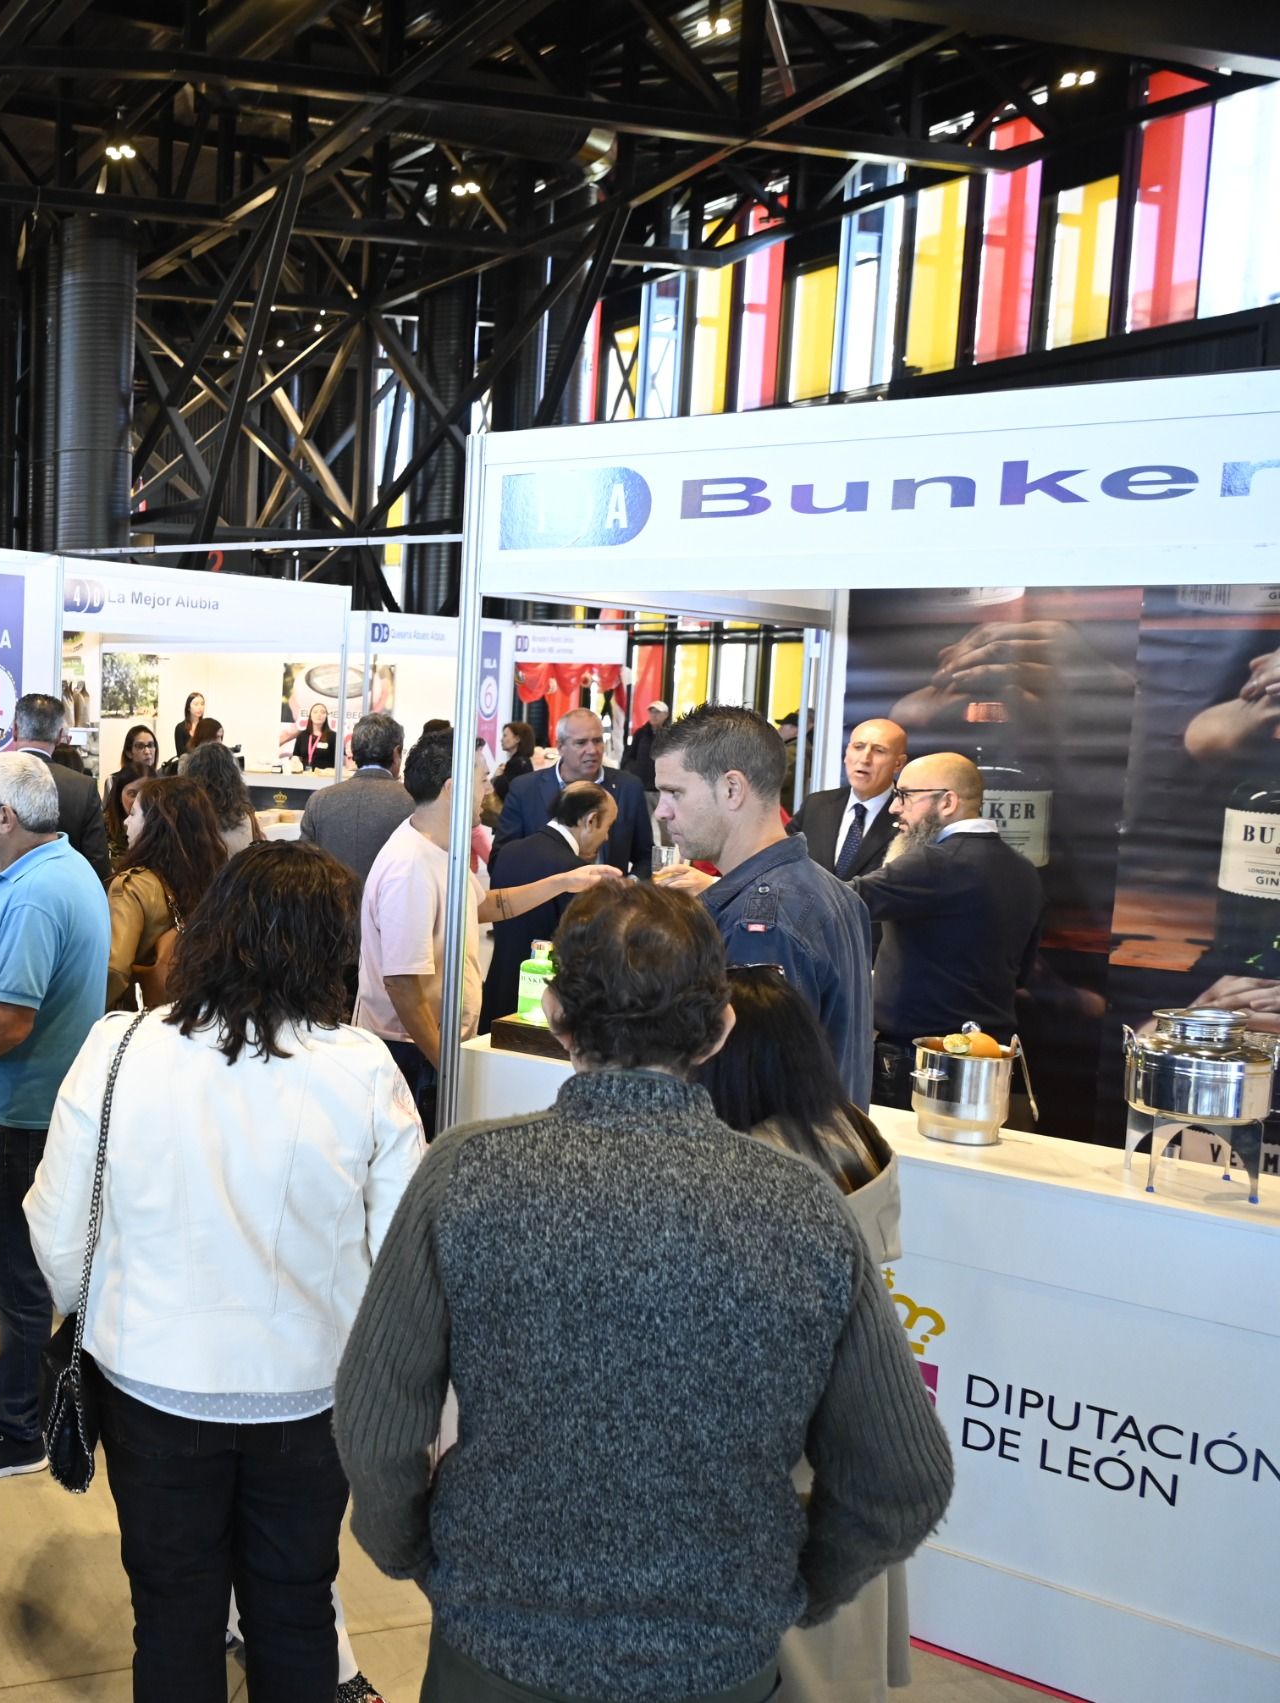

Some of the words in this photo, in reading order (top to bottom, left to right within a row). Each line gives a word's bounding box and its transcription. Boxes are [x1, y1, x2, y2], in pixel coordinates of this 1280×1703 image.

[604, 482, 629, 529] A
[679, 458, 1280, 520] Bunker
[108, 590, 125, 604] La
[131, 591, 171, 609] Mejor
[175, 594, 220, 610] Alubia
[484, 682, 493, 709] 6
[979, 803, 1035, 820] KER
[1255, 876, 1280, 887] GIN
[965, 1373, 1280, 1483] DIPUTACIÓN
[961, 1416, 1022, 1463] DE
[1039, 1438, 1180, 1508] LEÓN
